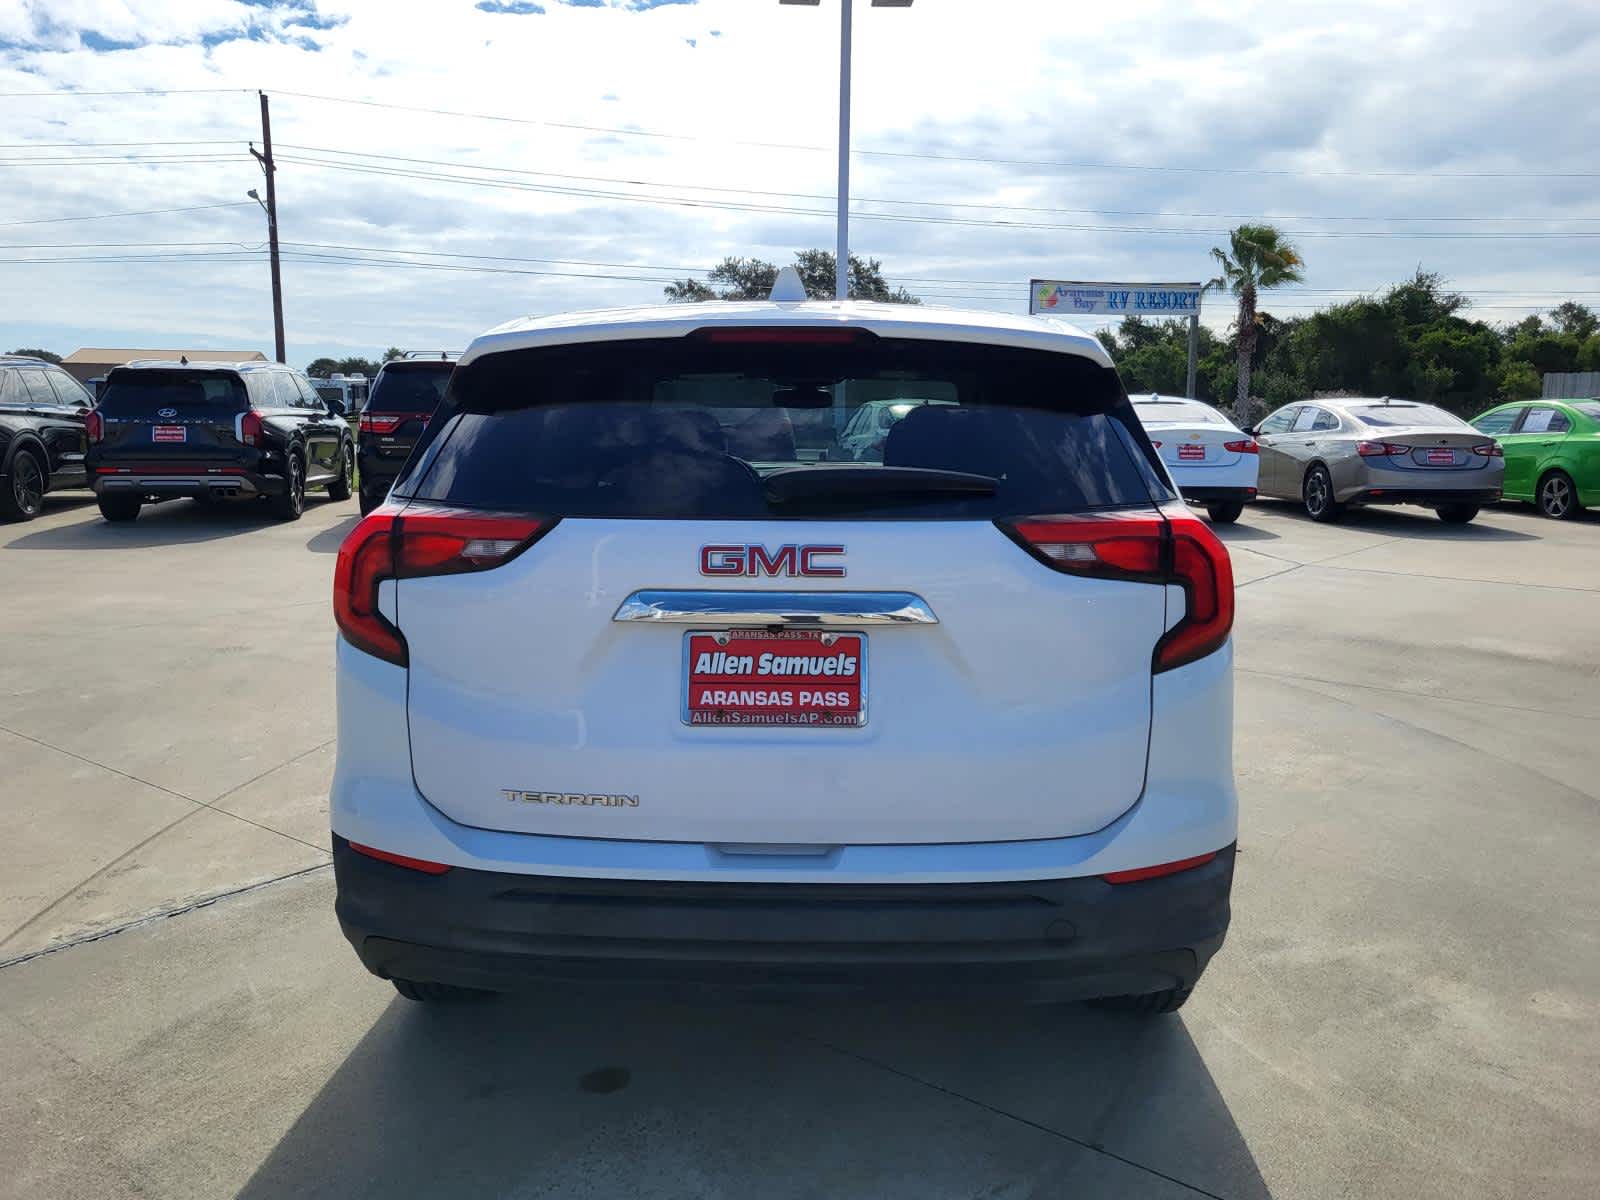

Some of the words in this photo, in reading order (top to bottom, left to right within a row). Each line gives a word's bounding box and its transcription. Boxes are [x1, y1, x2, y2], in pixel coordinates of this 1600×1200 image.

[1073, 297, 1097, 312] Bay
[1108, 291, 1131, 310] RV
[1135, 291, 1200, 310] RESORT
[699, 544, 848, 577] GMC
[694, 652, 754, 676] Allen
[757, 652, 857, 676] Samuels
[700, 691, 793, 706] ARANSAS
[799, 691, 850, 706] PASS
[500, 788, 640, 808] TERRAIN
